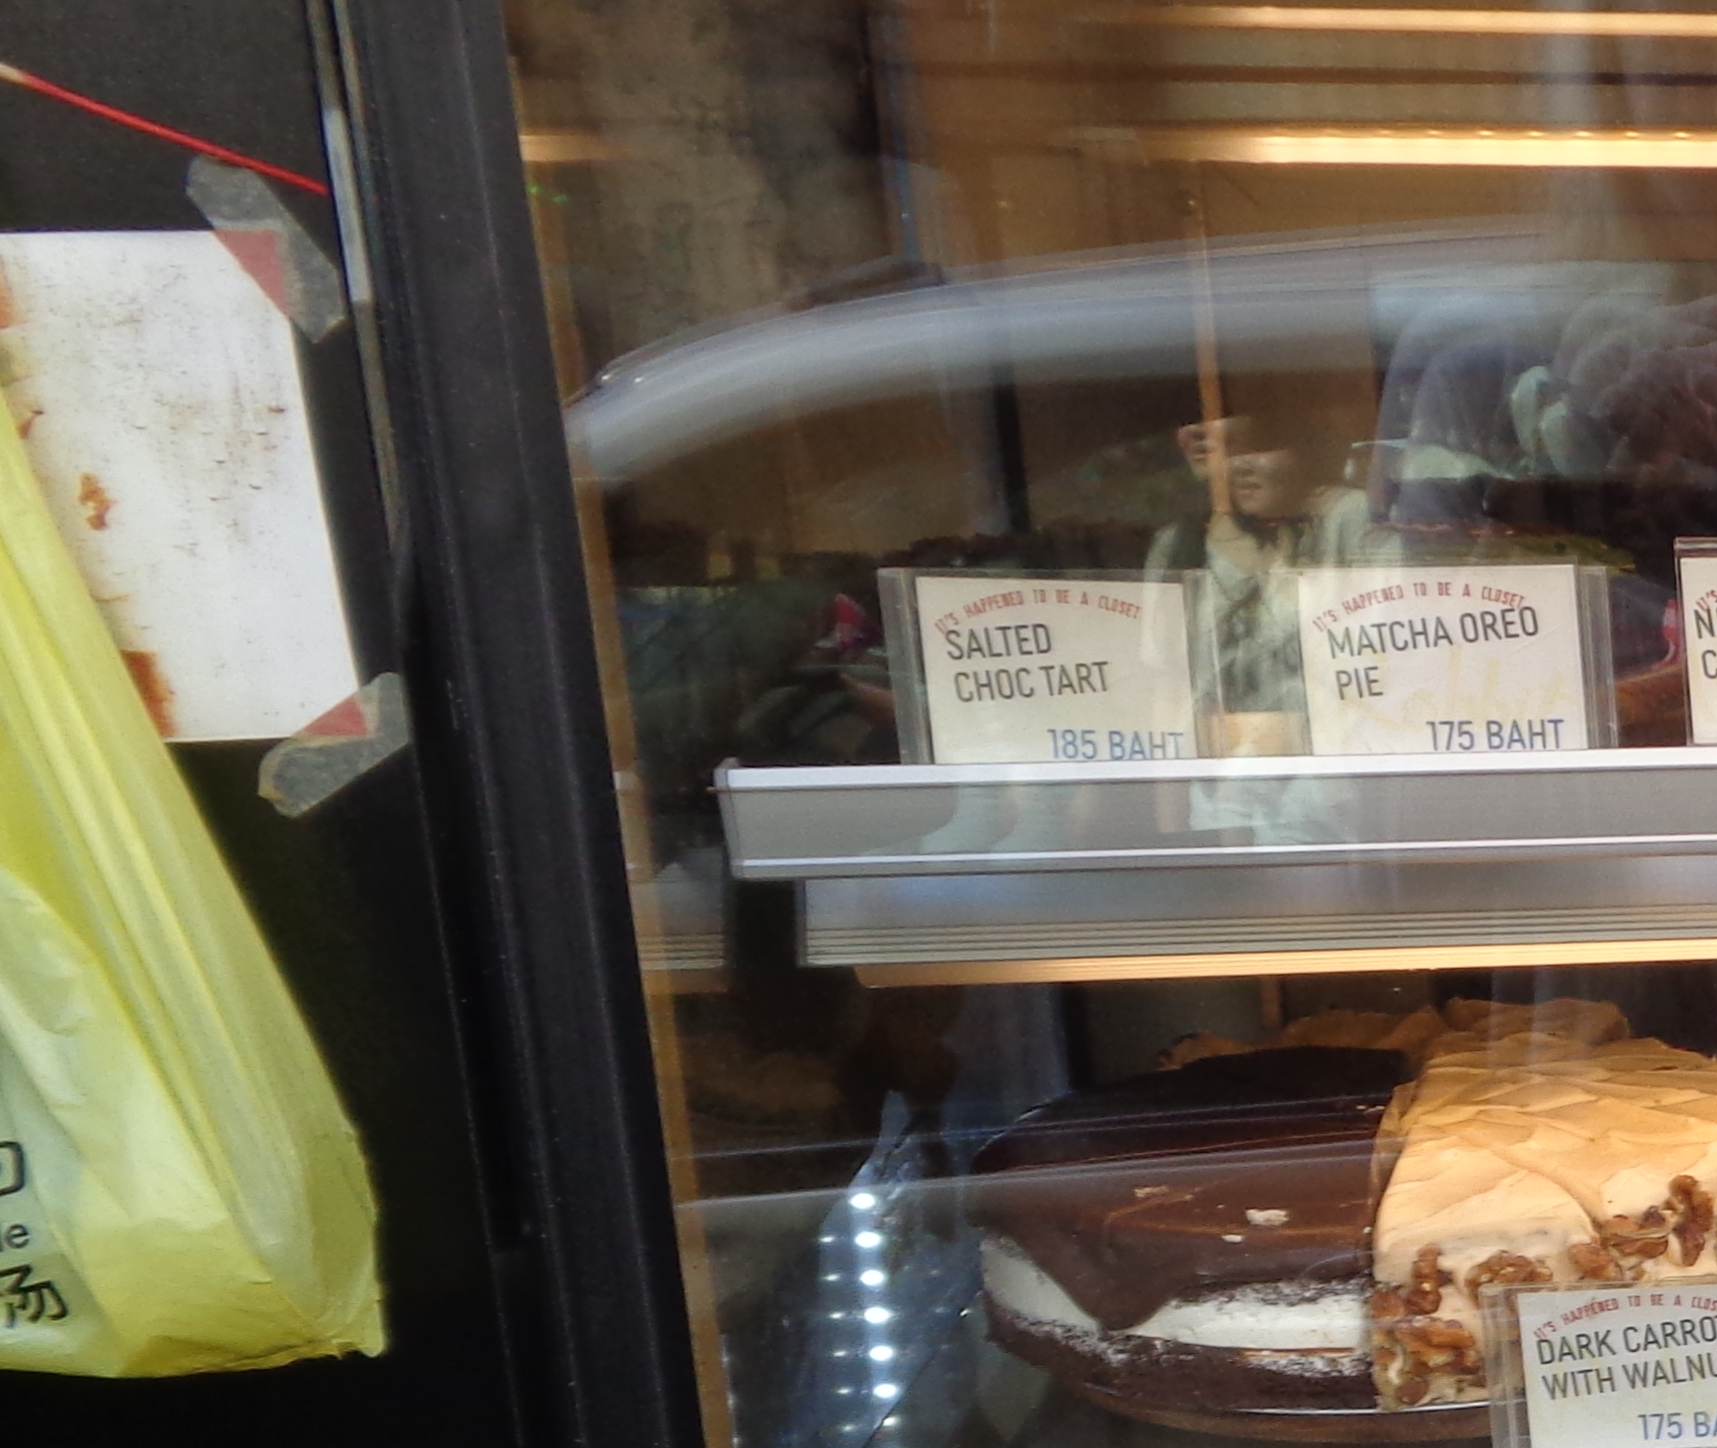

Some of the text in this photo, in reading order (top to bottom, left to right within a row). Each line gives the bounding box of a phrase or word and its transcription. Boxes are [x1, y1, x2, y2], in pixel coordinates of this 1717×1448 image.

[945, 624, 1052, 660] SALTED
[1327, 606, 1538, 659] MATCHA OREO
[954, 661, 1108, 702] CHOC TART
[1336, 666, 1384, 700] PIE
[1048, 729, 1184, 760] 185 BAHT
[1426, 719, 1564, 750] 175 BAHT
[1537, 1330, 1616, 1364] DARK
[1542, 1367, 1616, 1400] WITH
[1638, 1413, 1682, 1440] 175
